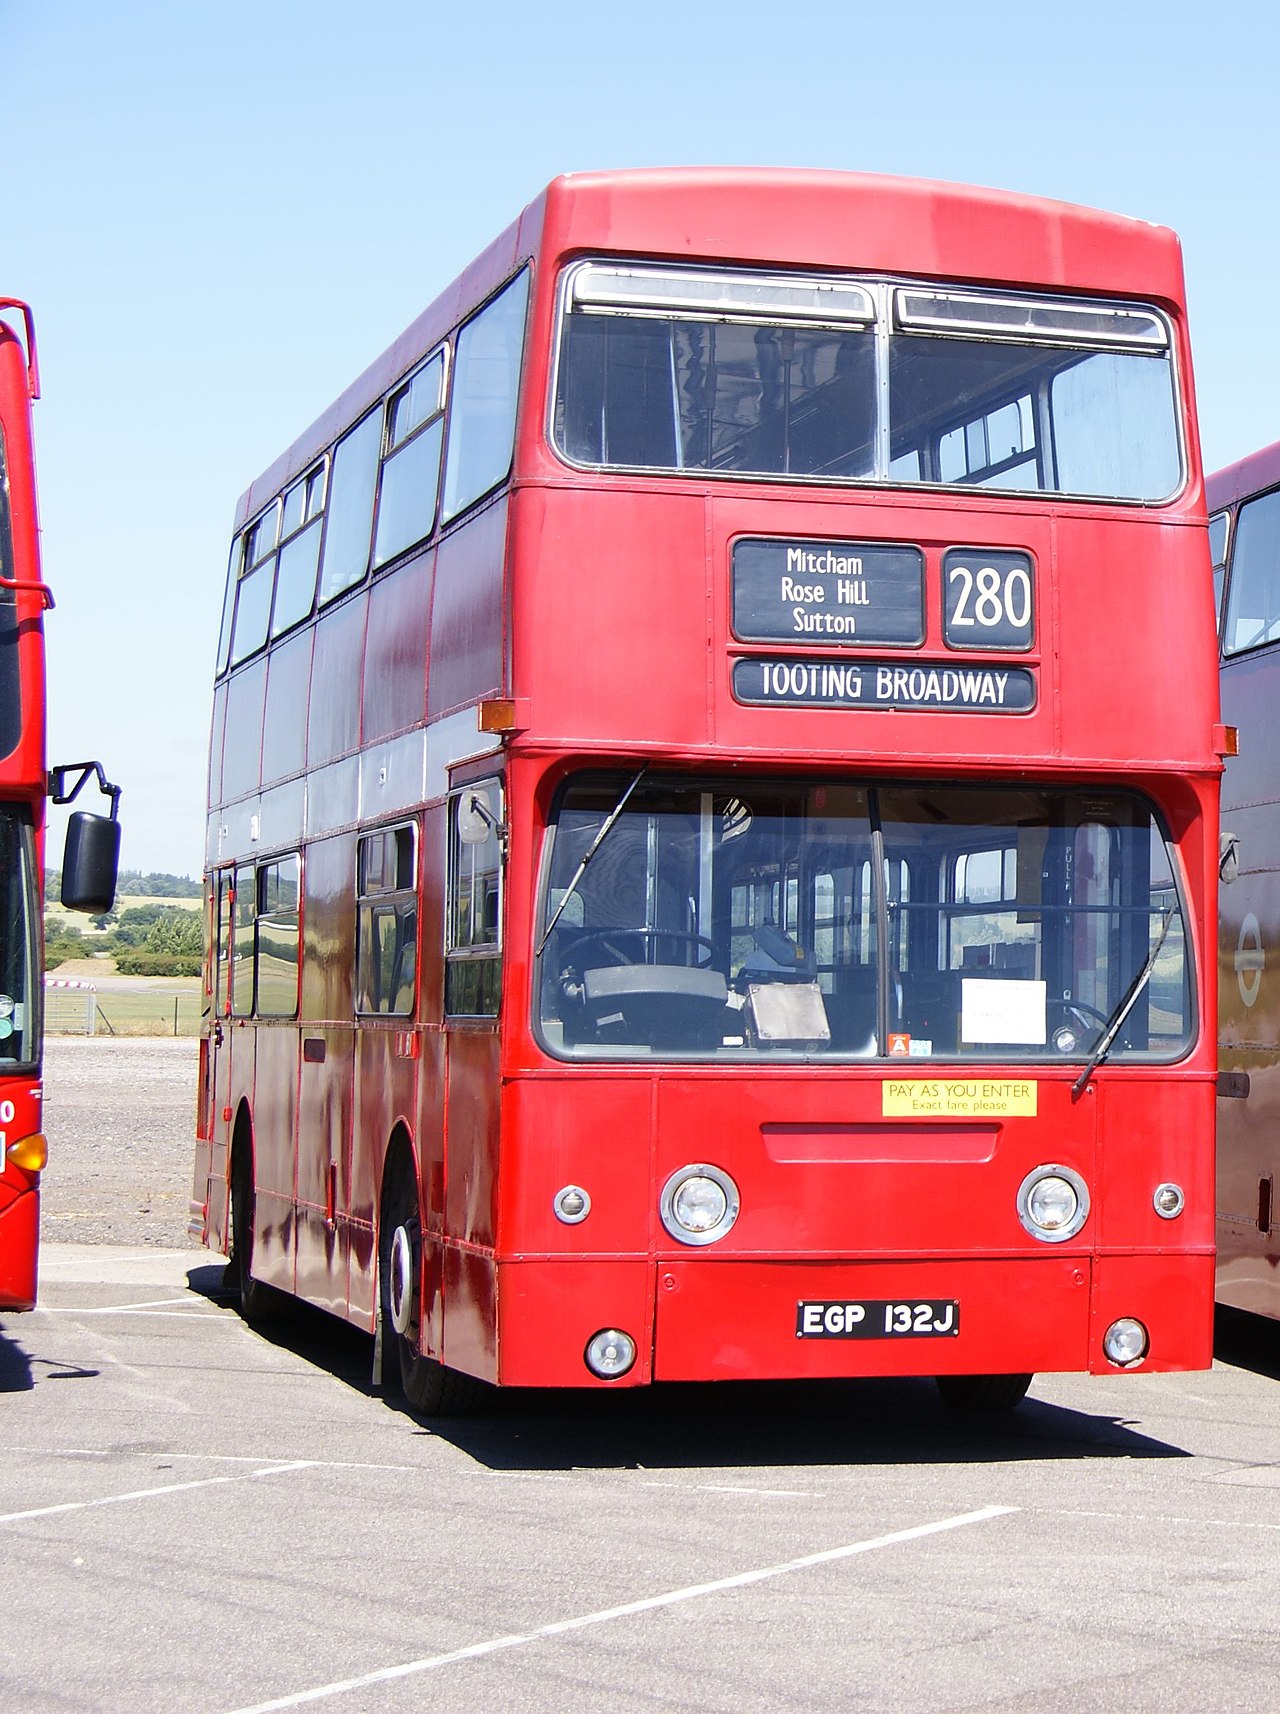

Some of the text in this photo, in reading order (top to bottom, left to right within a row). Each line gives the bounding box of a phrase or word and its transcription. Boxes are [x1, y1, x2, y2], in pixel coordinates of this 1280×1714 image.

[787, 548, 862, 575] Mitcham
[781, 577, 870, 605] Rose Hill
[949, 566, 1030, 628] 280
[794, 608, 855, 634] Sutton
[760, 662, 1009, 704] TOOTING BROADWAY
[890, 1085, 1030, 1097] PAY AS YOU ENTER
[913, 1100, 1007, 1112] Exact fare please
[803, 1304, 953, 1333] EGP 132J
